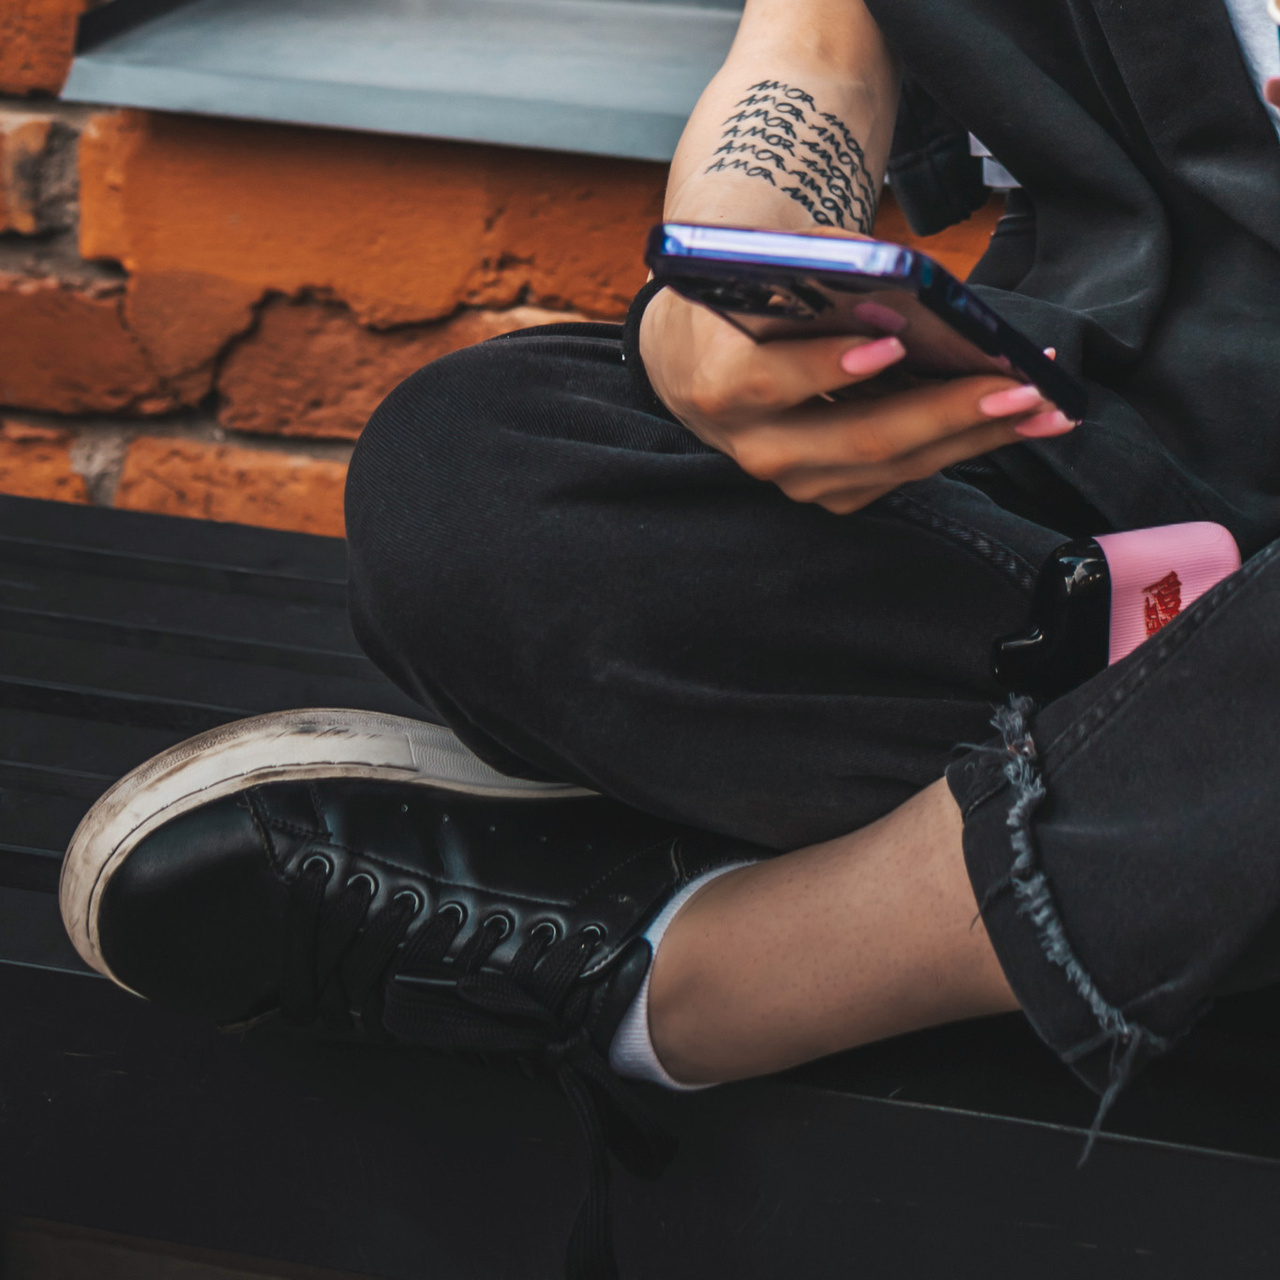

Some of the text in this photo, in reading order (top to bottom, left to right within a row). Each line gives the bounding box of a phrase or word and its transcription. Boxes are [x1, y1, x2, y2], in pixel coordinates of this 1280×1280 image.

[735, 94, 806, 124] AMOR
[746, 79, 816, 112] AMOR
[722, 108, 797, 140] AMOR
[713, 140, 787, 172] AMOR
[721, 124, 795, 157] AMOR
[704, 157, 777, 187] AMOR
